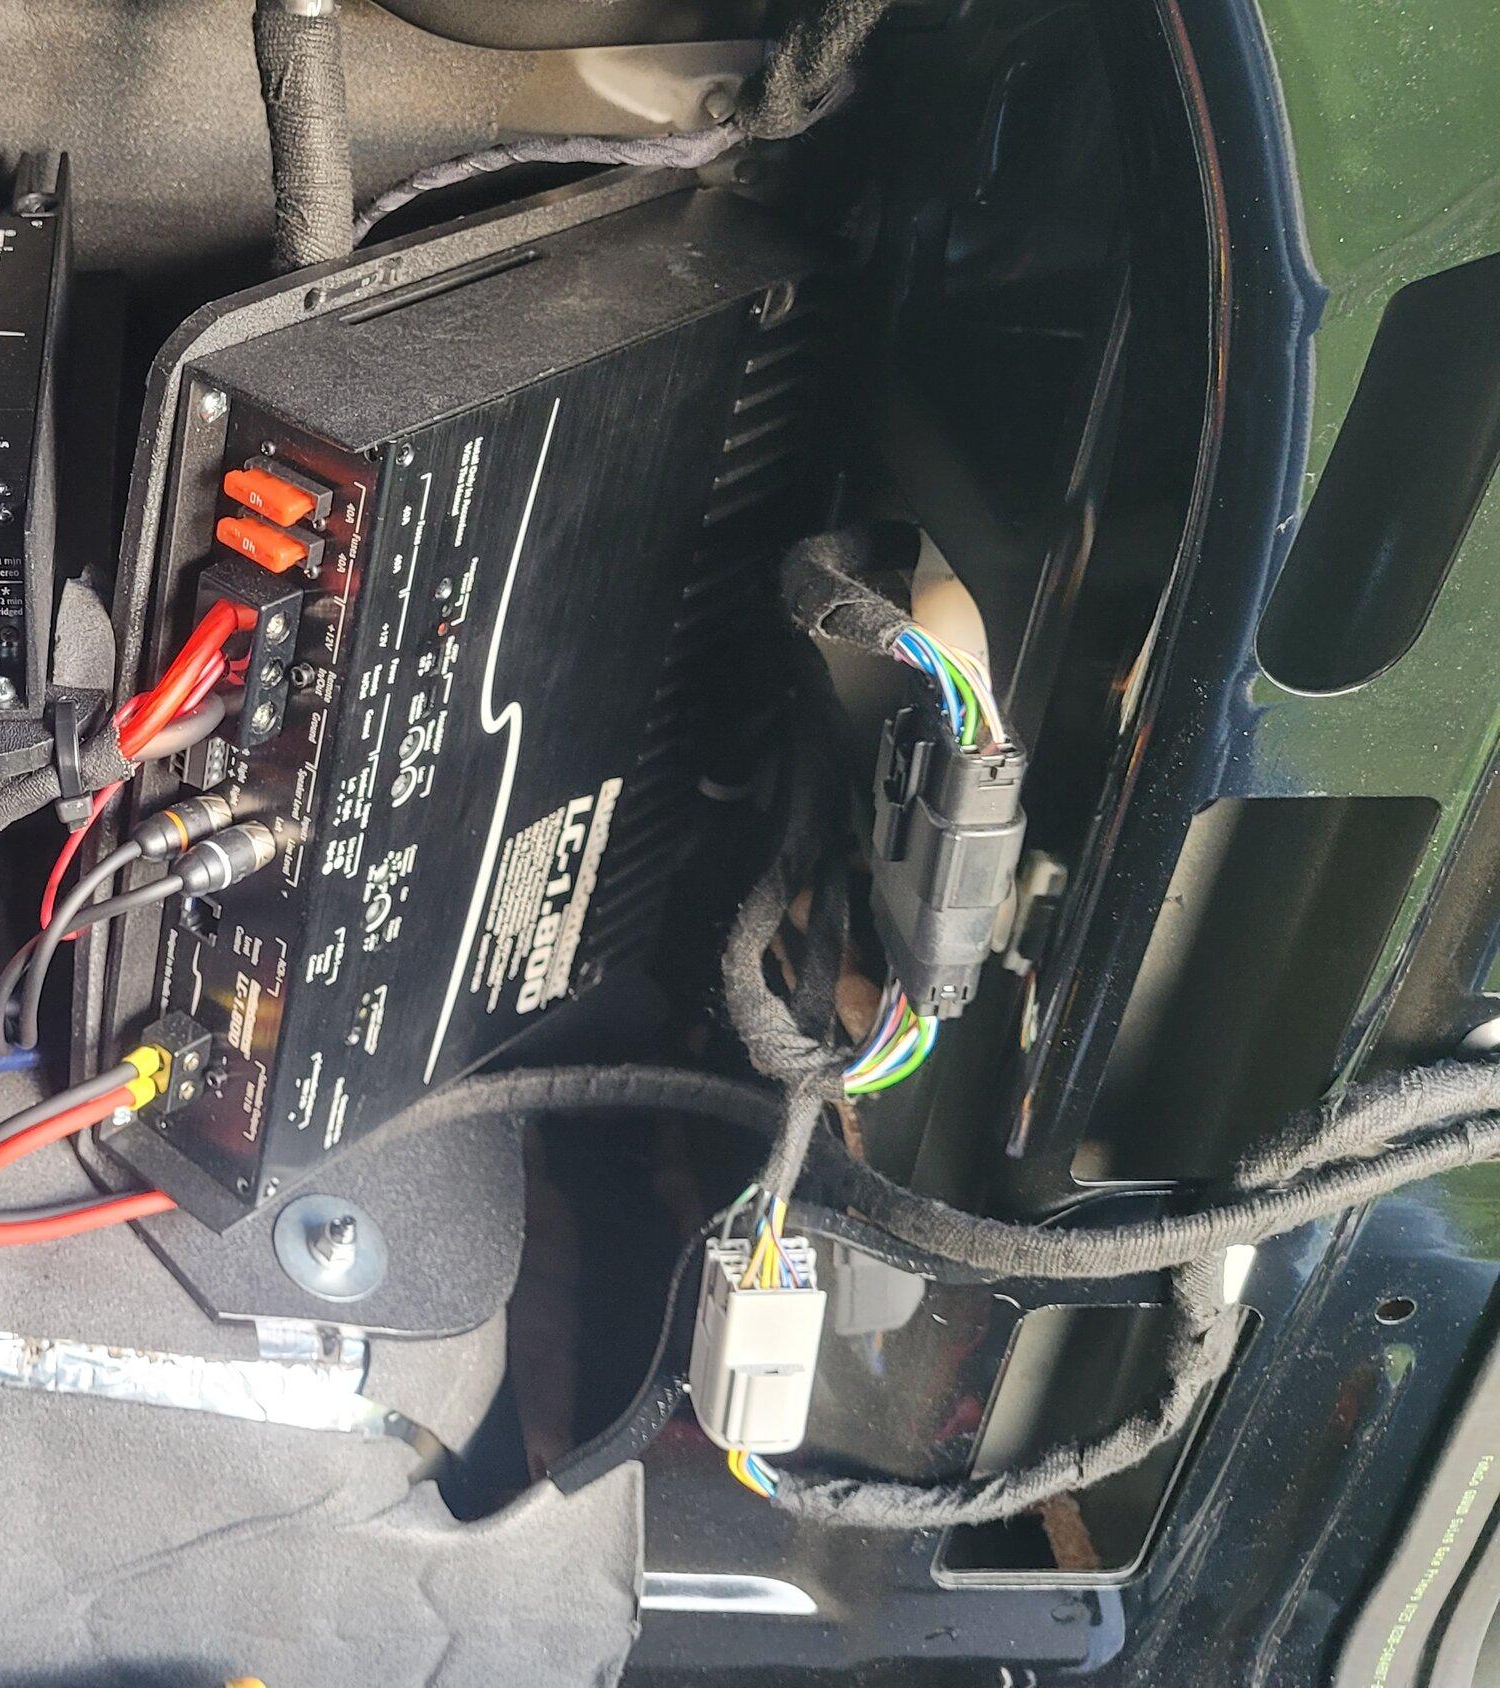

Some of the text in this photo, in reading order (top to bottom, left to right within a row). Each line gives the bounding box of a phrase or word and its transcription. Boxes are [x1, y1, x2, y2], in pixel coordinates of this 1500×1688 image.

[349, 533, 361, 558] Fuses
[325, 625, 334, 651] +12V
[324, 671, 337, 703] Remote
[309, 713, 320, 744] Ground
[516, 795, 594, 1014] LC-1.800
[228, 972, 249, 1048] LC-1.800
